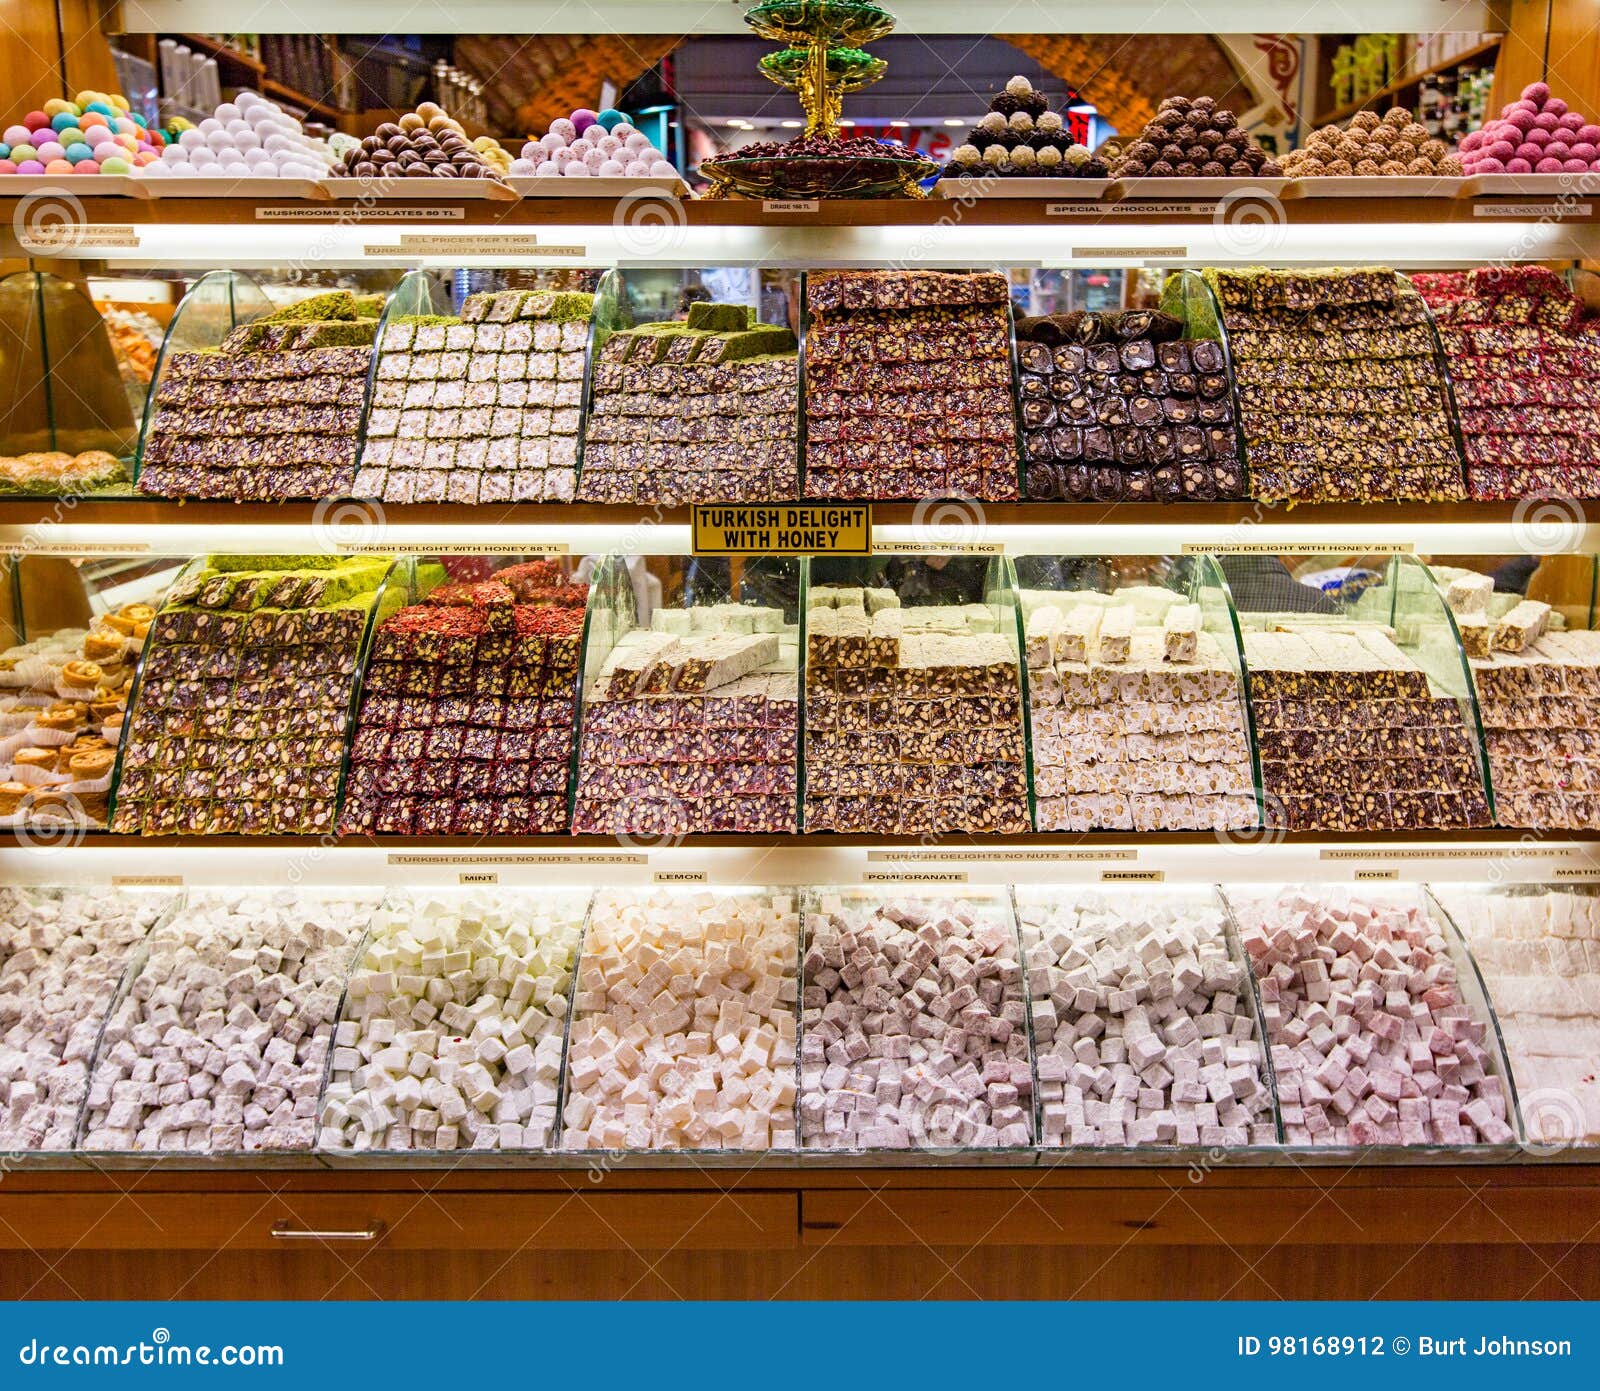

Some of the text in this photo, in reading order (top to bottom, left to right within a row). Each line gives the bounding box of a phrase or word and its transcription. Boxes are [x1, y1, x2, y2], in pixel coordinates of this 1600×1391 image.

[700, 509, 864, 529] TURKISH DELIGHT
[724, 530, 839, 549] WITH HONEY
